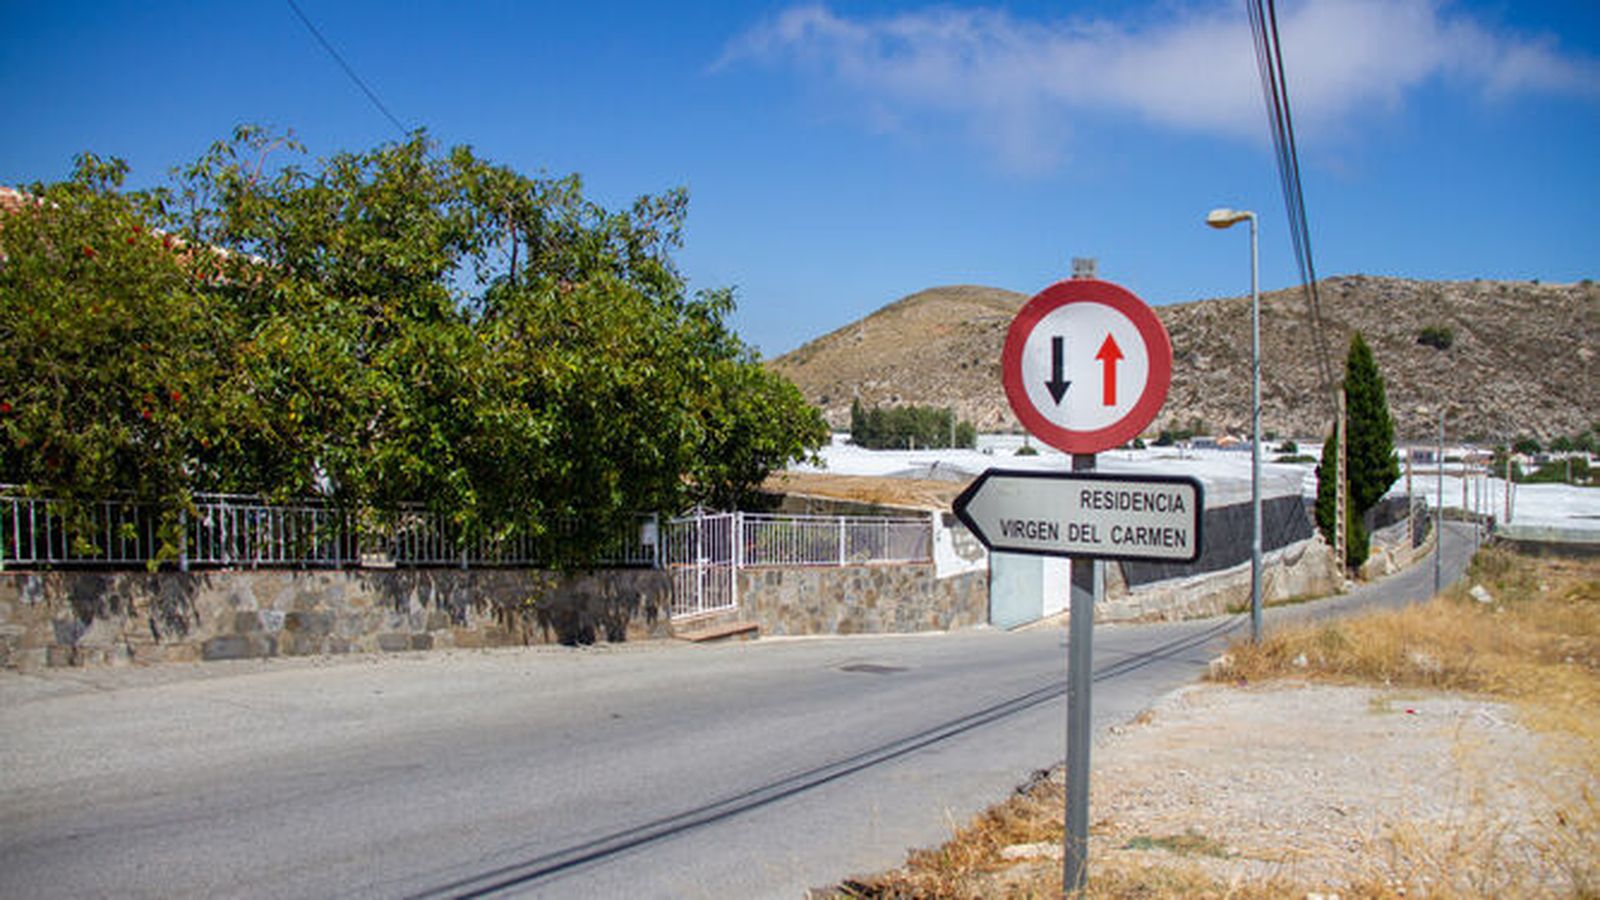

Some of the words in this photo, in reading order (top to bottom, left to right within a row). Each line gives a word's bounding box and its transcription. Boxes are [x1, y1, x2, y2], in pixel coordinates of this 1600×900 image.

[1080, 490, 1185, 513] RESIDENCIA
[1000, 519, 1059, 541] VIRGEN
[1069, 523, 1101, 544] DEL
[1111, 525, 1186, 547] CARMEN
